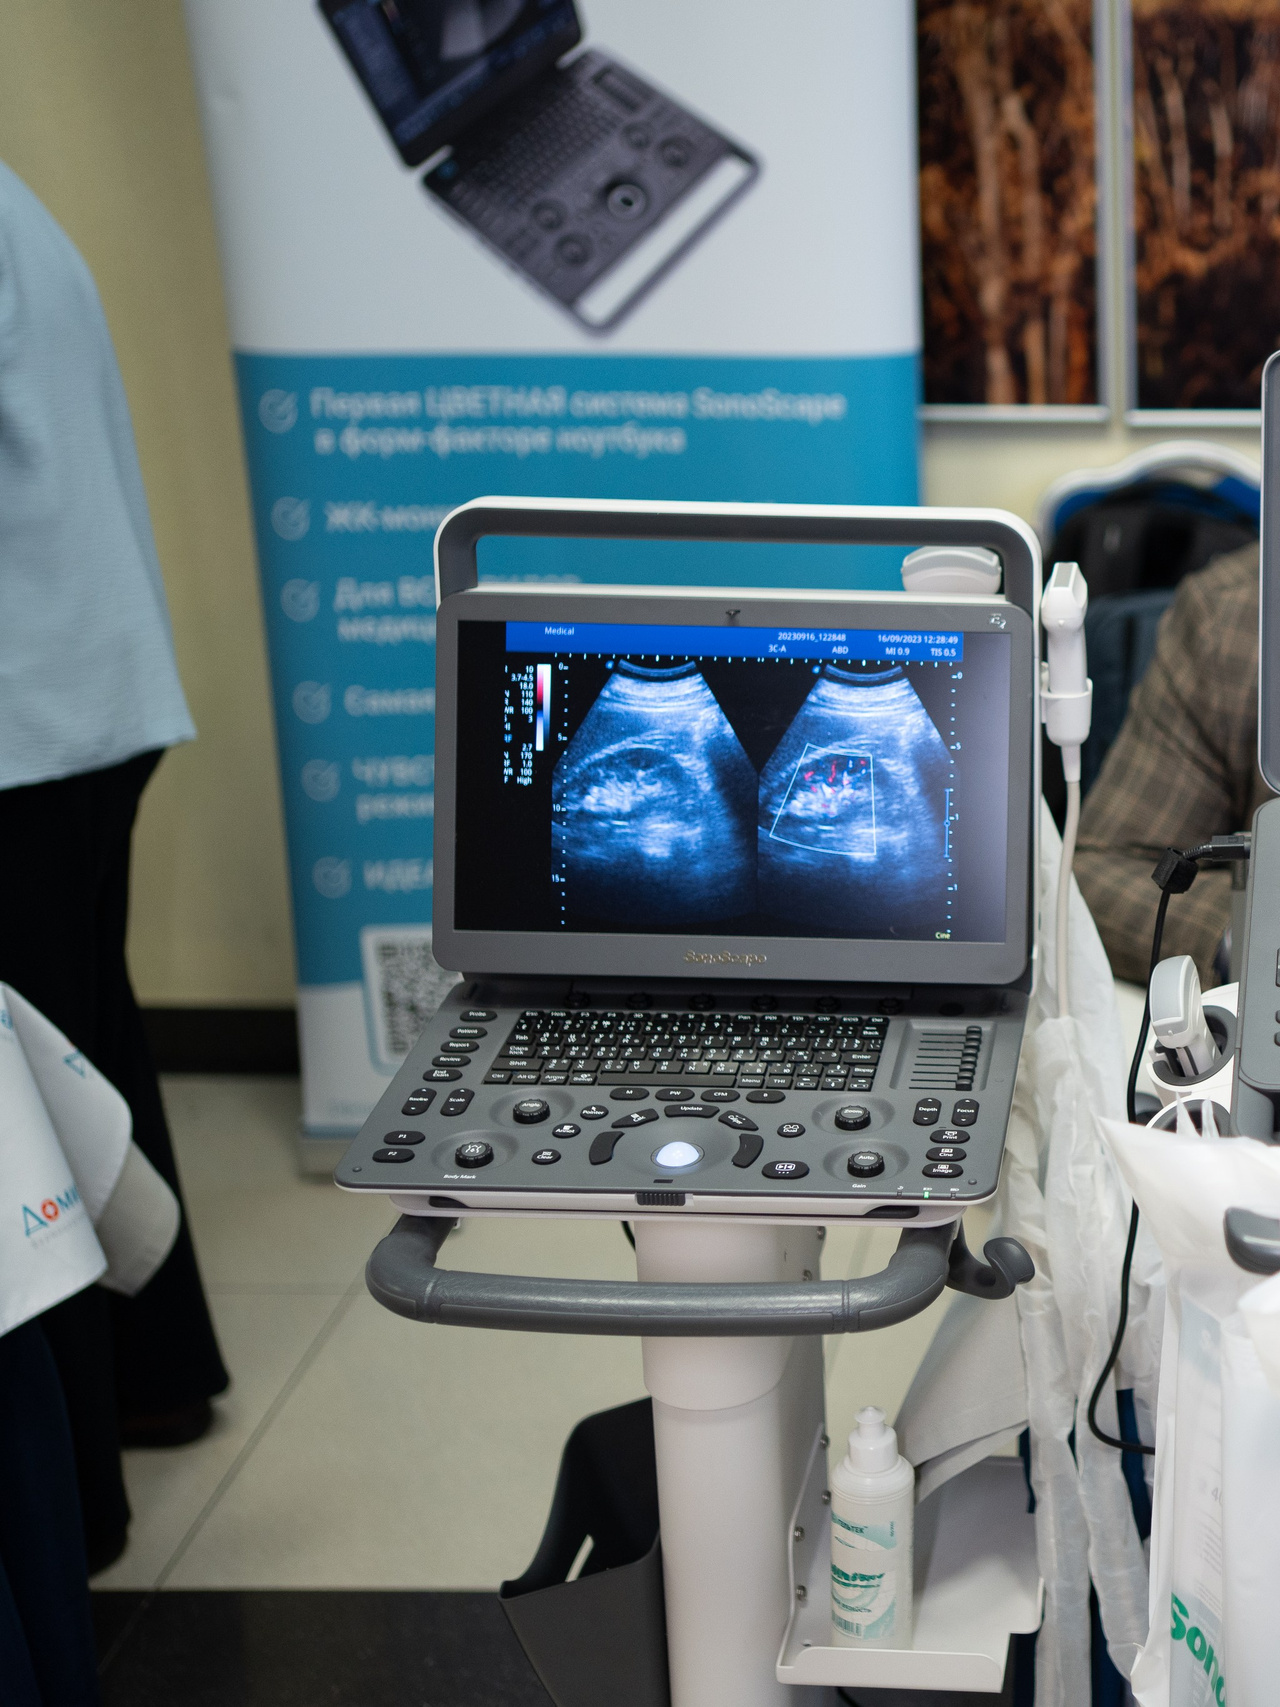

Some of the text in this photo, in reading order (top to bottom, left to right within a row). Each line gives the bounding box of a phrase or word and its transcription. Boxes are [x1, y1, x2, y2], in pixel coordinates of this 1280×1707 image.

[545, 627, 575, 635] Medical
[778, 632, 958, 644] 20230916_122848 16/09/2023 12:28:49
[768, 645, 956, 657] 3C-A ABD MI 0.9 TIS 0.5
[521, 690, 533, 698] 110
[521, 707, 533, 715] 100
[520, 768, 532, 776] 100
[517, 776, 532, 786] High
[935, 932, 950, 940] Cine
[683, 950, 766, 966] SonoScape
